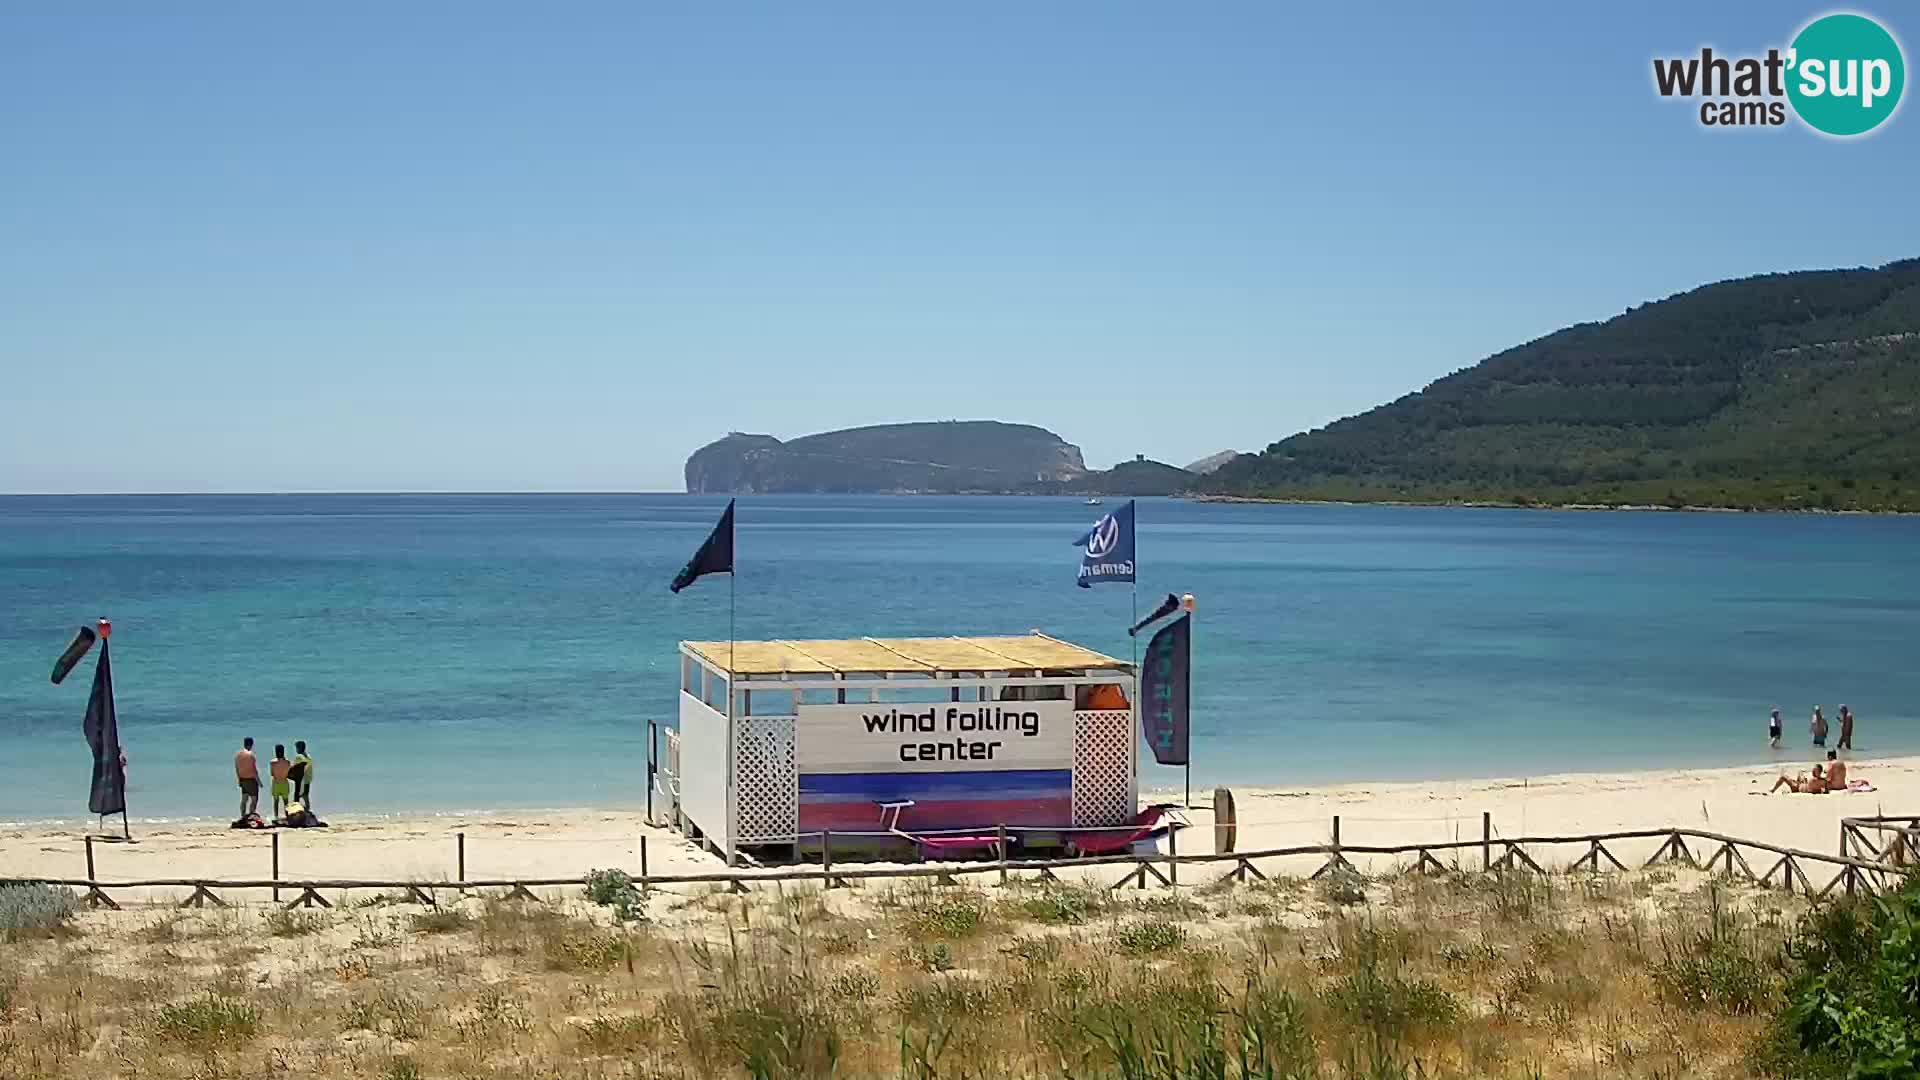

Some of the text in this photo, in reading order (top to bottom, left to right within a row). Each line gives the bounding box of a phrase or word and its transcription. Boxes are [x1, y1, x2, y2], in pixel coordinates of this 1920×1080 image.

[863, 708, 1038, 736] wind foiling
[901, 738, 1002, 761] center
